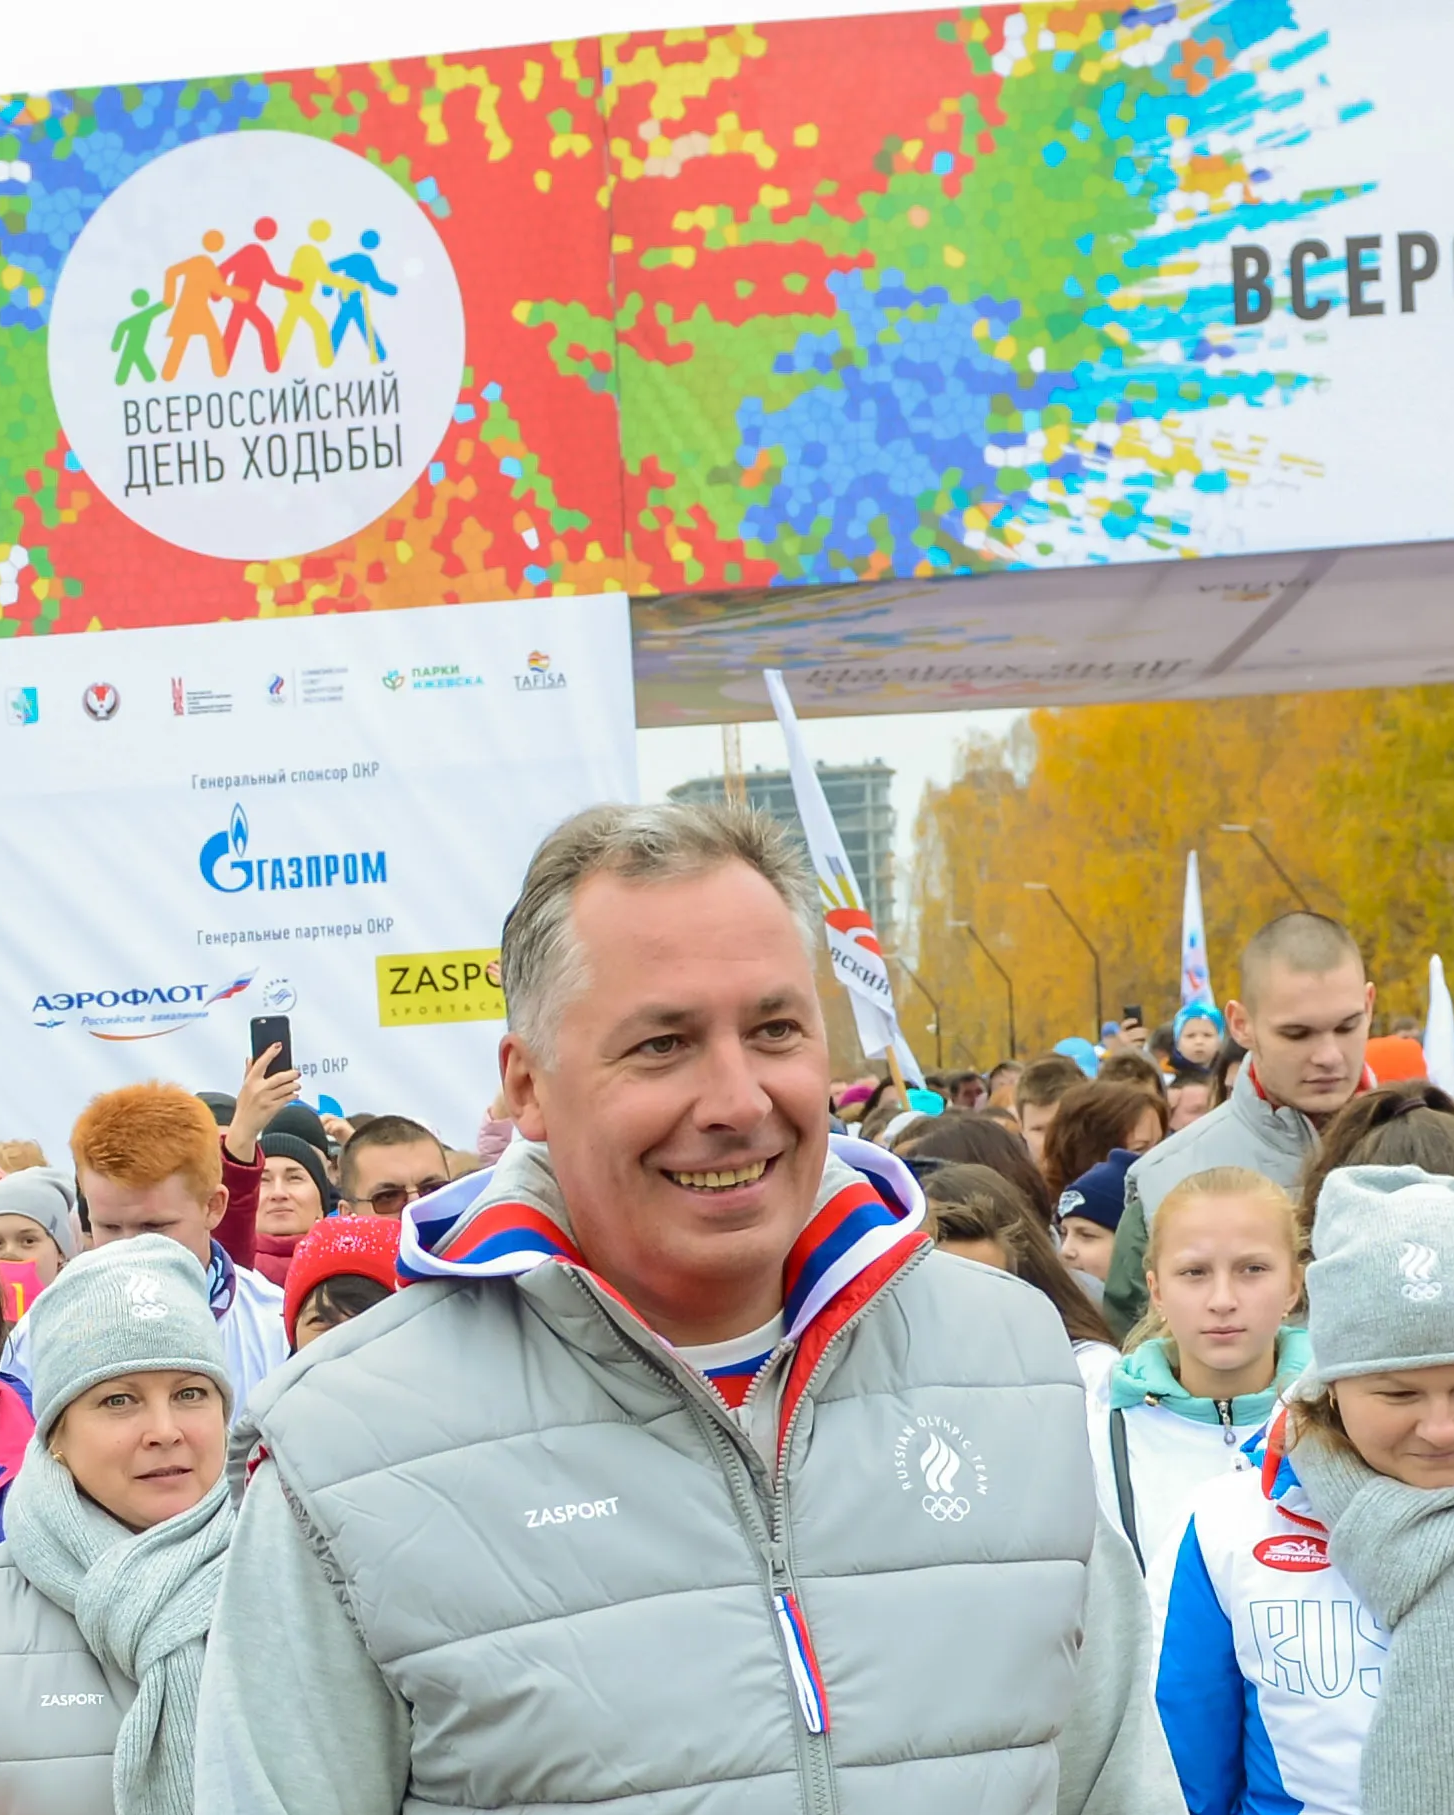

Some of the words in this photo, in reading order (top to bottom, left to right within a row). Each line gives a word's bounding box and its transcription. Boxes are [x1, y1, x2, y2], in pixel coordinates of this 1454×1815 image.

[124, 372, 401, 436] ВСЕРОССИЙСКИЙ
[124, 435, 224, 497] ДЕНЬ
[243, 423, 403, 482] ХОДЬБЫ
[412, 665, 459, 677] ПАРКИ
[514, 673, 566, 688] TAFISA
[192, 769, 286, 790] Генеральный
[291, 767, 348, 782] спонсор
[353, 762, 379, 778] ОКР
[257, 851, 387, 891] ГАЗПРОМ
[198, 929, 290, 946] Генеральные
[295, 923, 362, 940] партнеры
[368, 918, 394, 934] ОКР
[32, 984, 208, 1012] АЭРОФЛОТ
[81, 1014, 145, 1026] Российские
[323, 1058, 348, 1073] ОКР
[895, 1425, 915, 1491] RUSSIAN
[917, 1415, 973, 1450] OLYMPIC
[972, 1455, 989, 1495] TEAM
[524, 1496, 619, 1528] ZASPORT
[41, 1694, 104, 1706] ZASPORT
